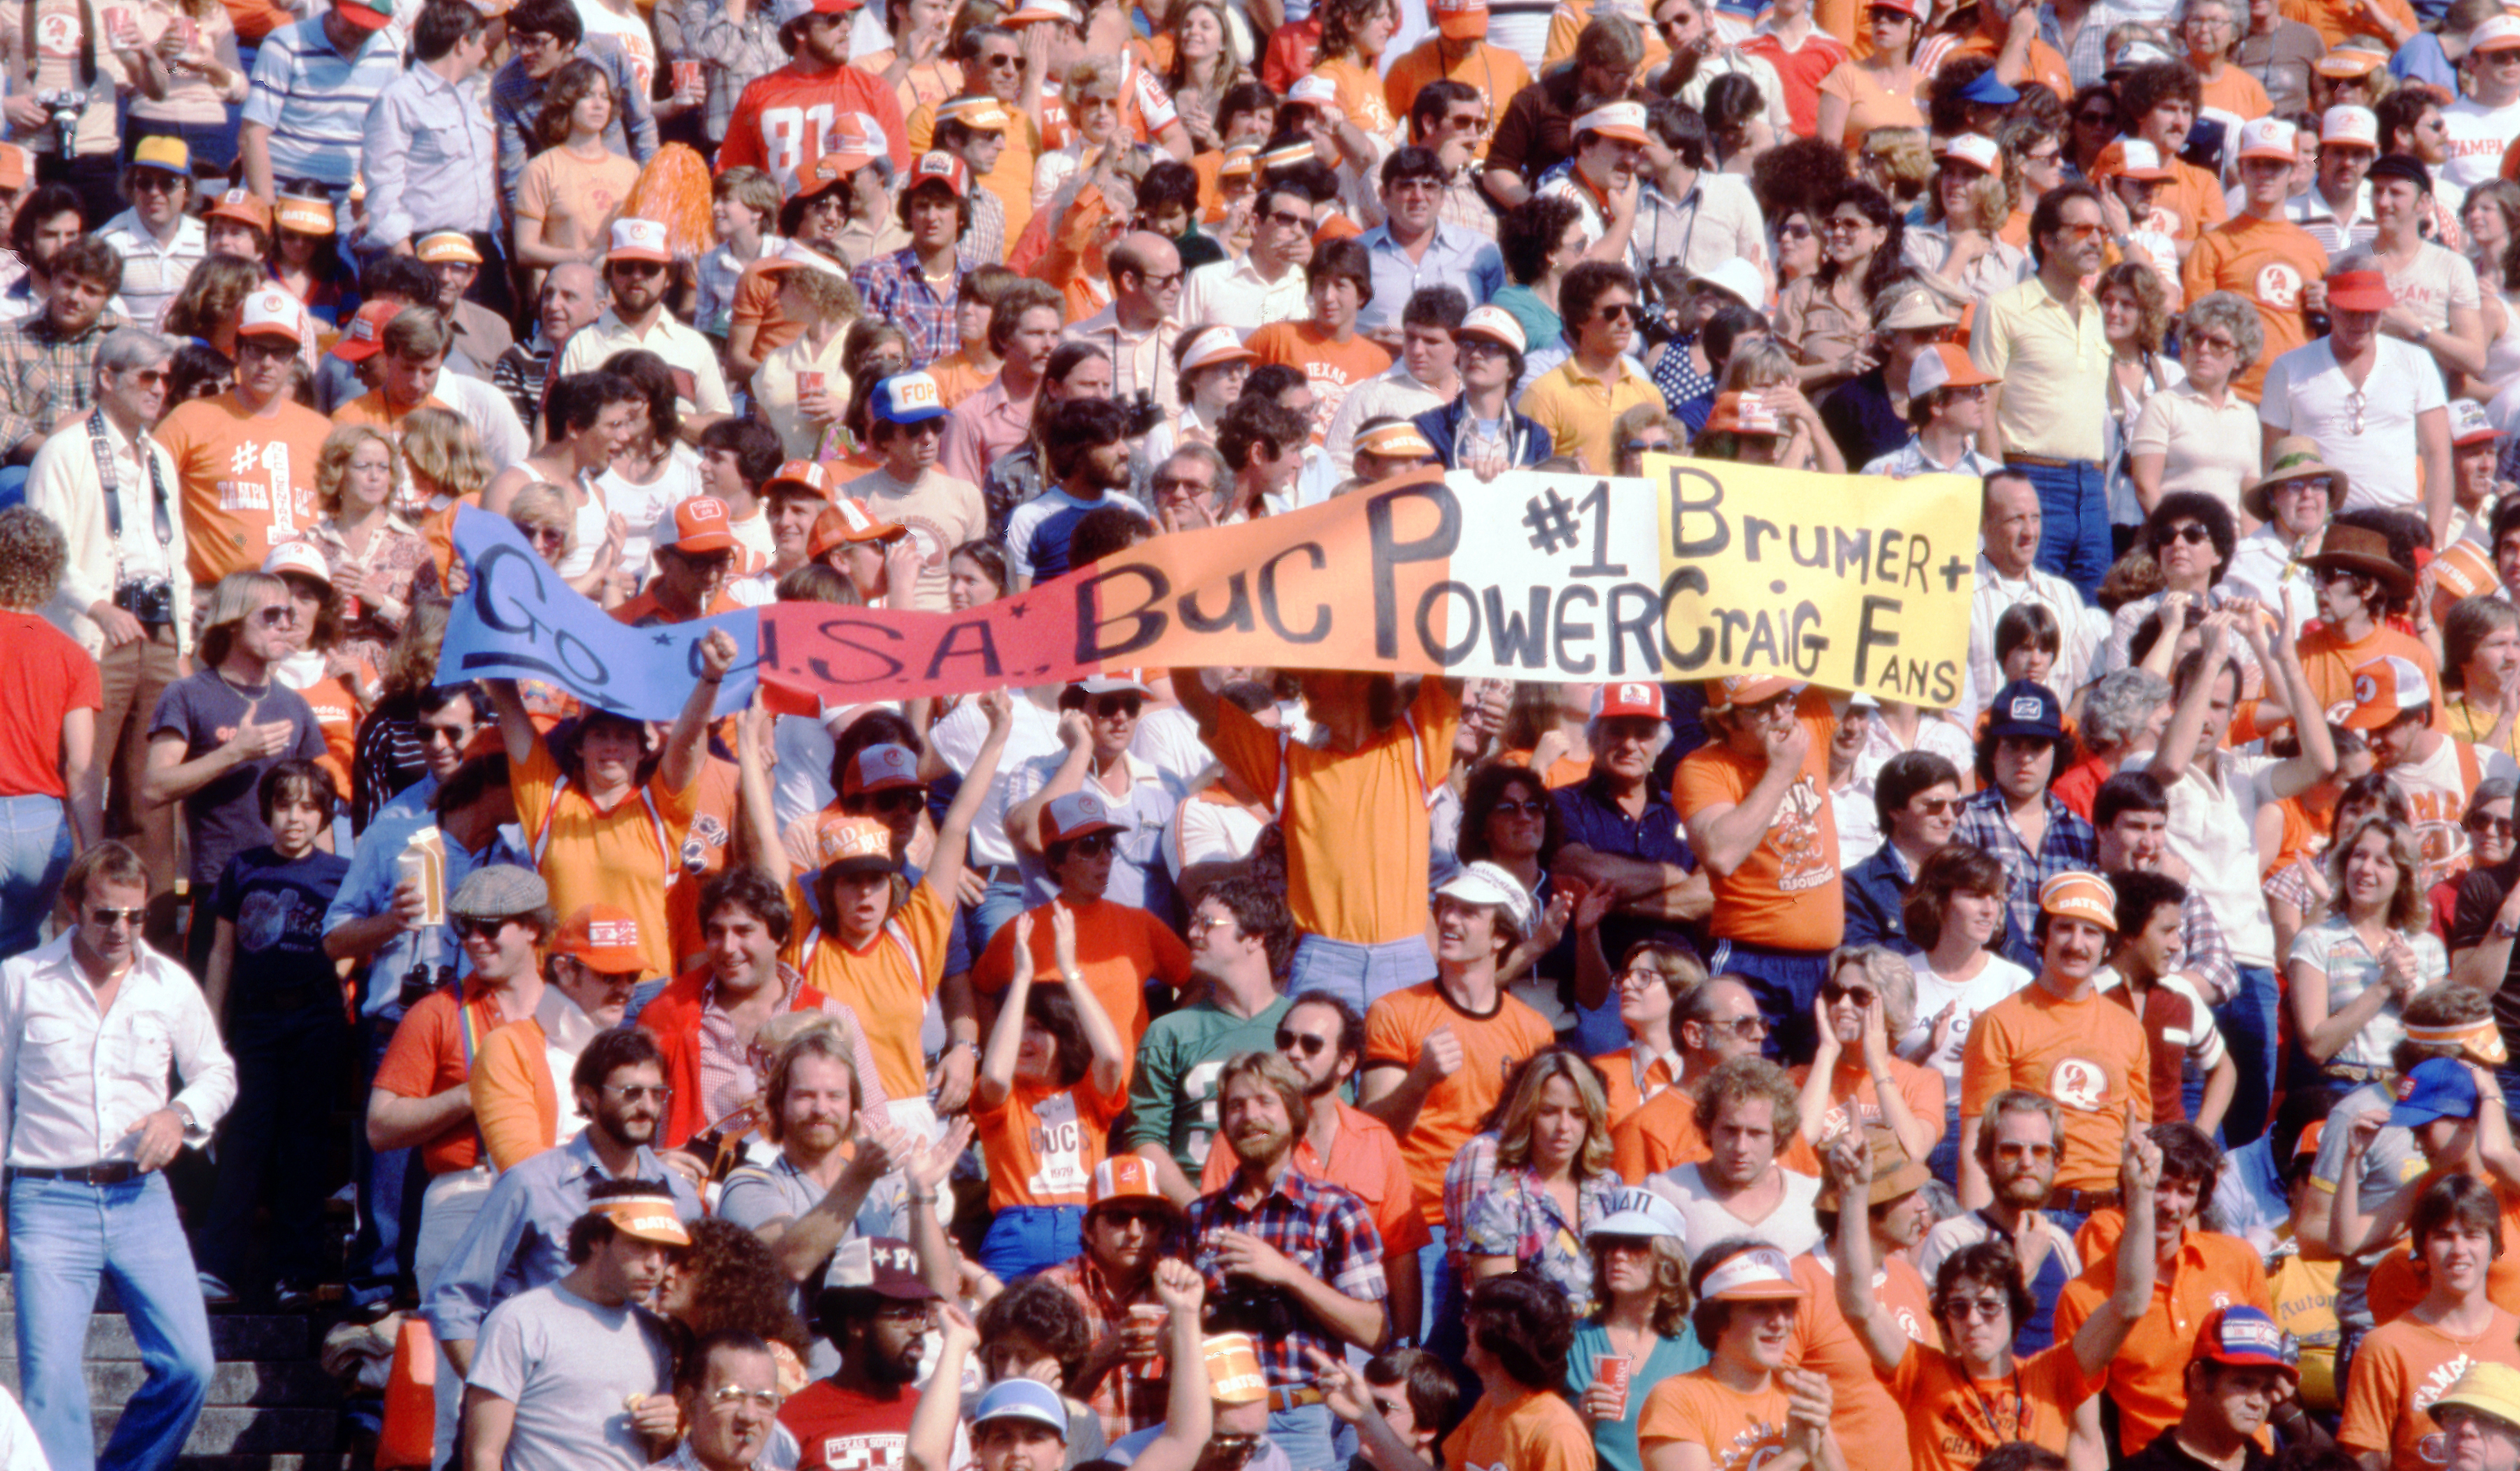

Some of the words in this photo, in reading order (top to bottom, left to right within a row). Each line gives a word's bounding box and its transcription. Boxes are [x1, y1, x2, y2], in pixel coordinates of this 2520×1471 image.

[975, 109, 1009, 124] DATS
[760, 106, 831, 185] 81
[2449, 138, 2505, 160] TAMPA
[281, 209, 329, 228] DATSUN
[1301, 361, 1346, 386] TEXAS
[216, 480, 270, 511] TAMPA
[1520, 479, 1629, 579] #1
[2430, 557, 2475, 595] DATSUN
[1851, 594, 1959, 704] FANS
[820, 825, 855, 857] BAD
[2059, 897, 2114, 925] DATS
[1030, 1122, 1091, 1155] BUCS
[1050, 1164, 1076, 1179] 1979
[632, 1215, 687, 1239] DATS
[1612, 1361, 1626, 1396] Coke
[2412, 1353, 2476, 1413] TAMP
[830, 1437, 866, 1454] TEXAS
